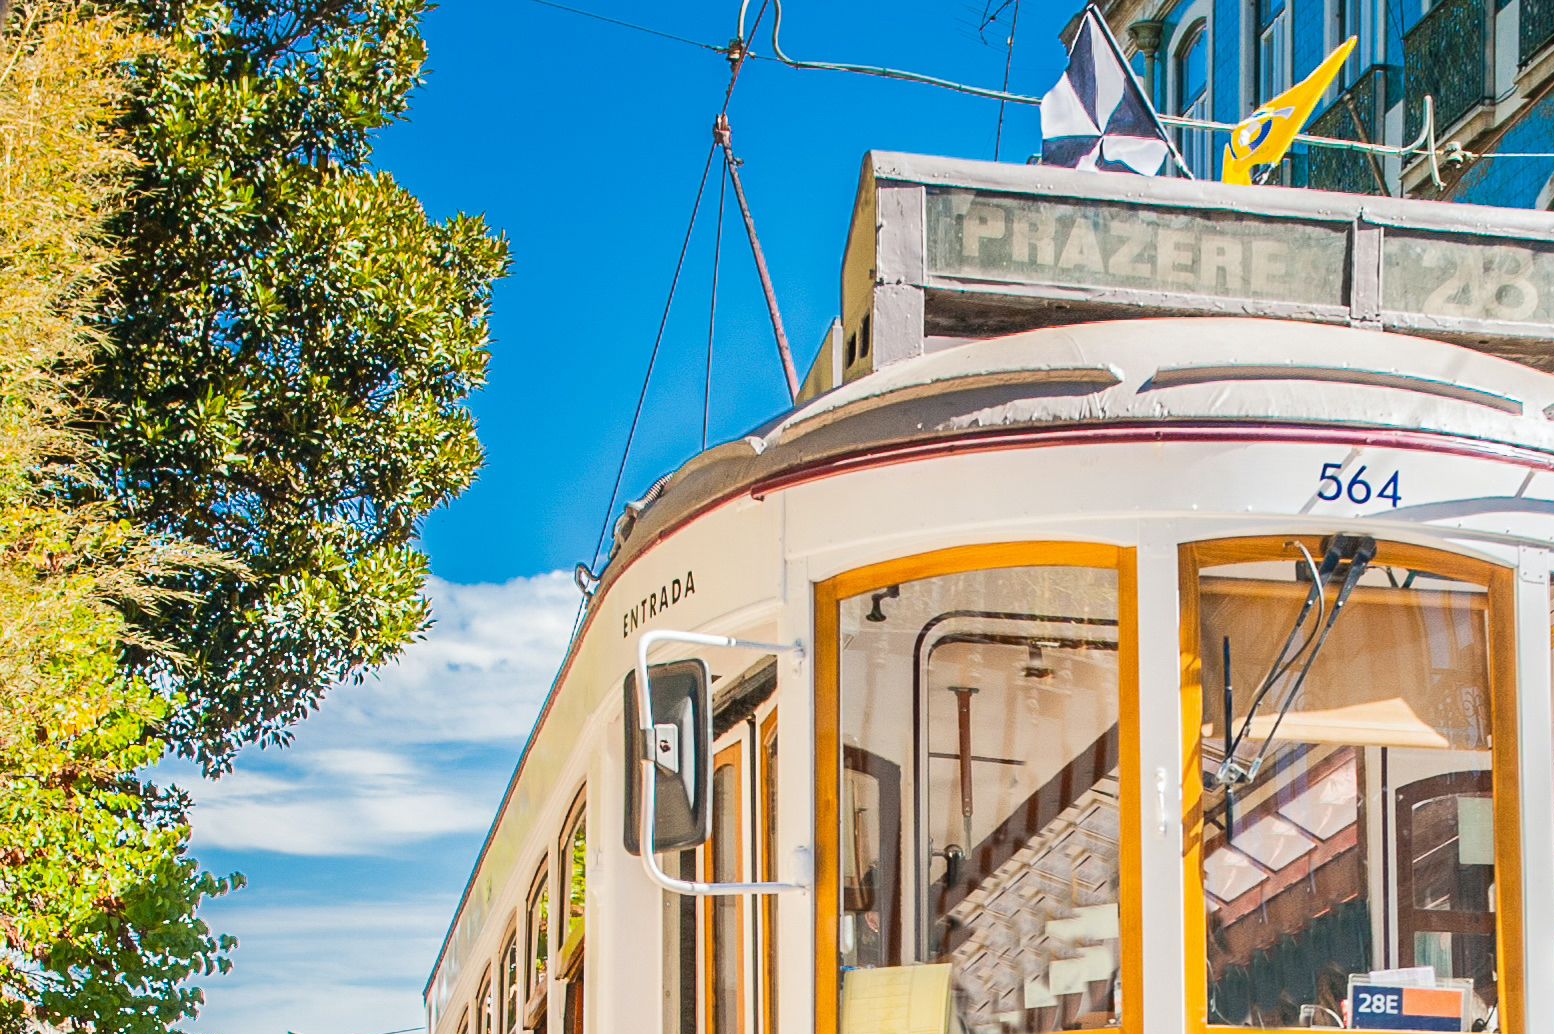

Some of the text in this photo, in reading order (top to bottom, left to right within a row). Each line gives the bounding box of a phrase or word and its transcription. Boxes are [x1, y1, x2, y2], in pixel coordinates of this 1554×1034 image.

[959, 205, 1538, 321] PRAZERE 28
[1317, 462, 1402, 508] 564
[623, 570, 696, 639] ENTRADA
[1358, 993, 1400, 1015] 28E
